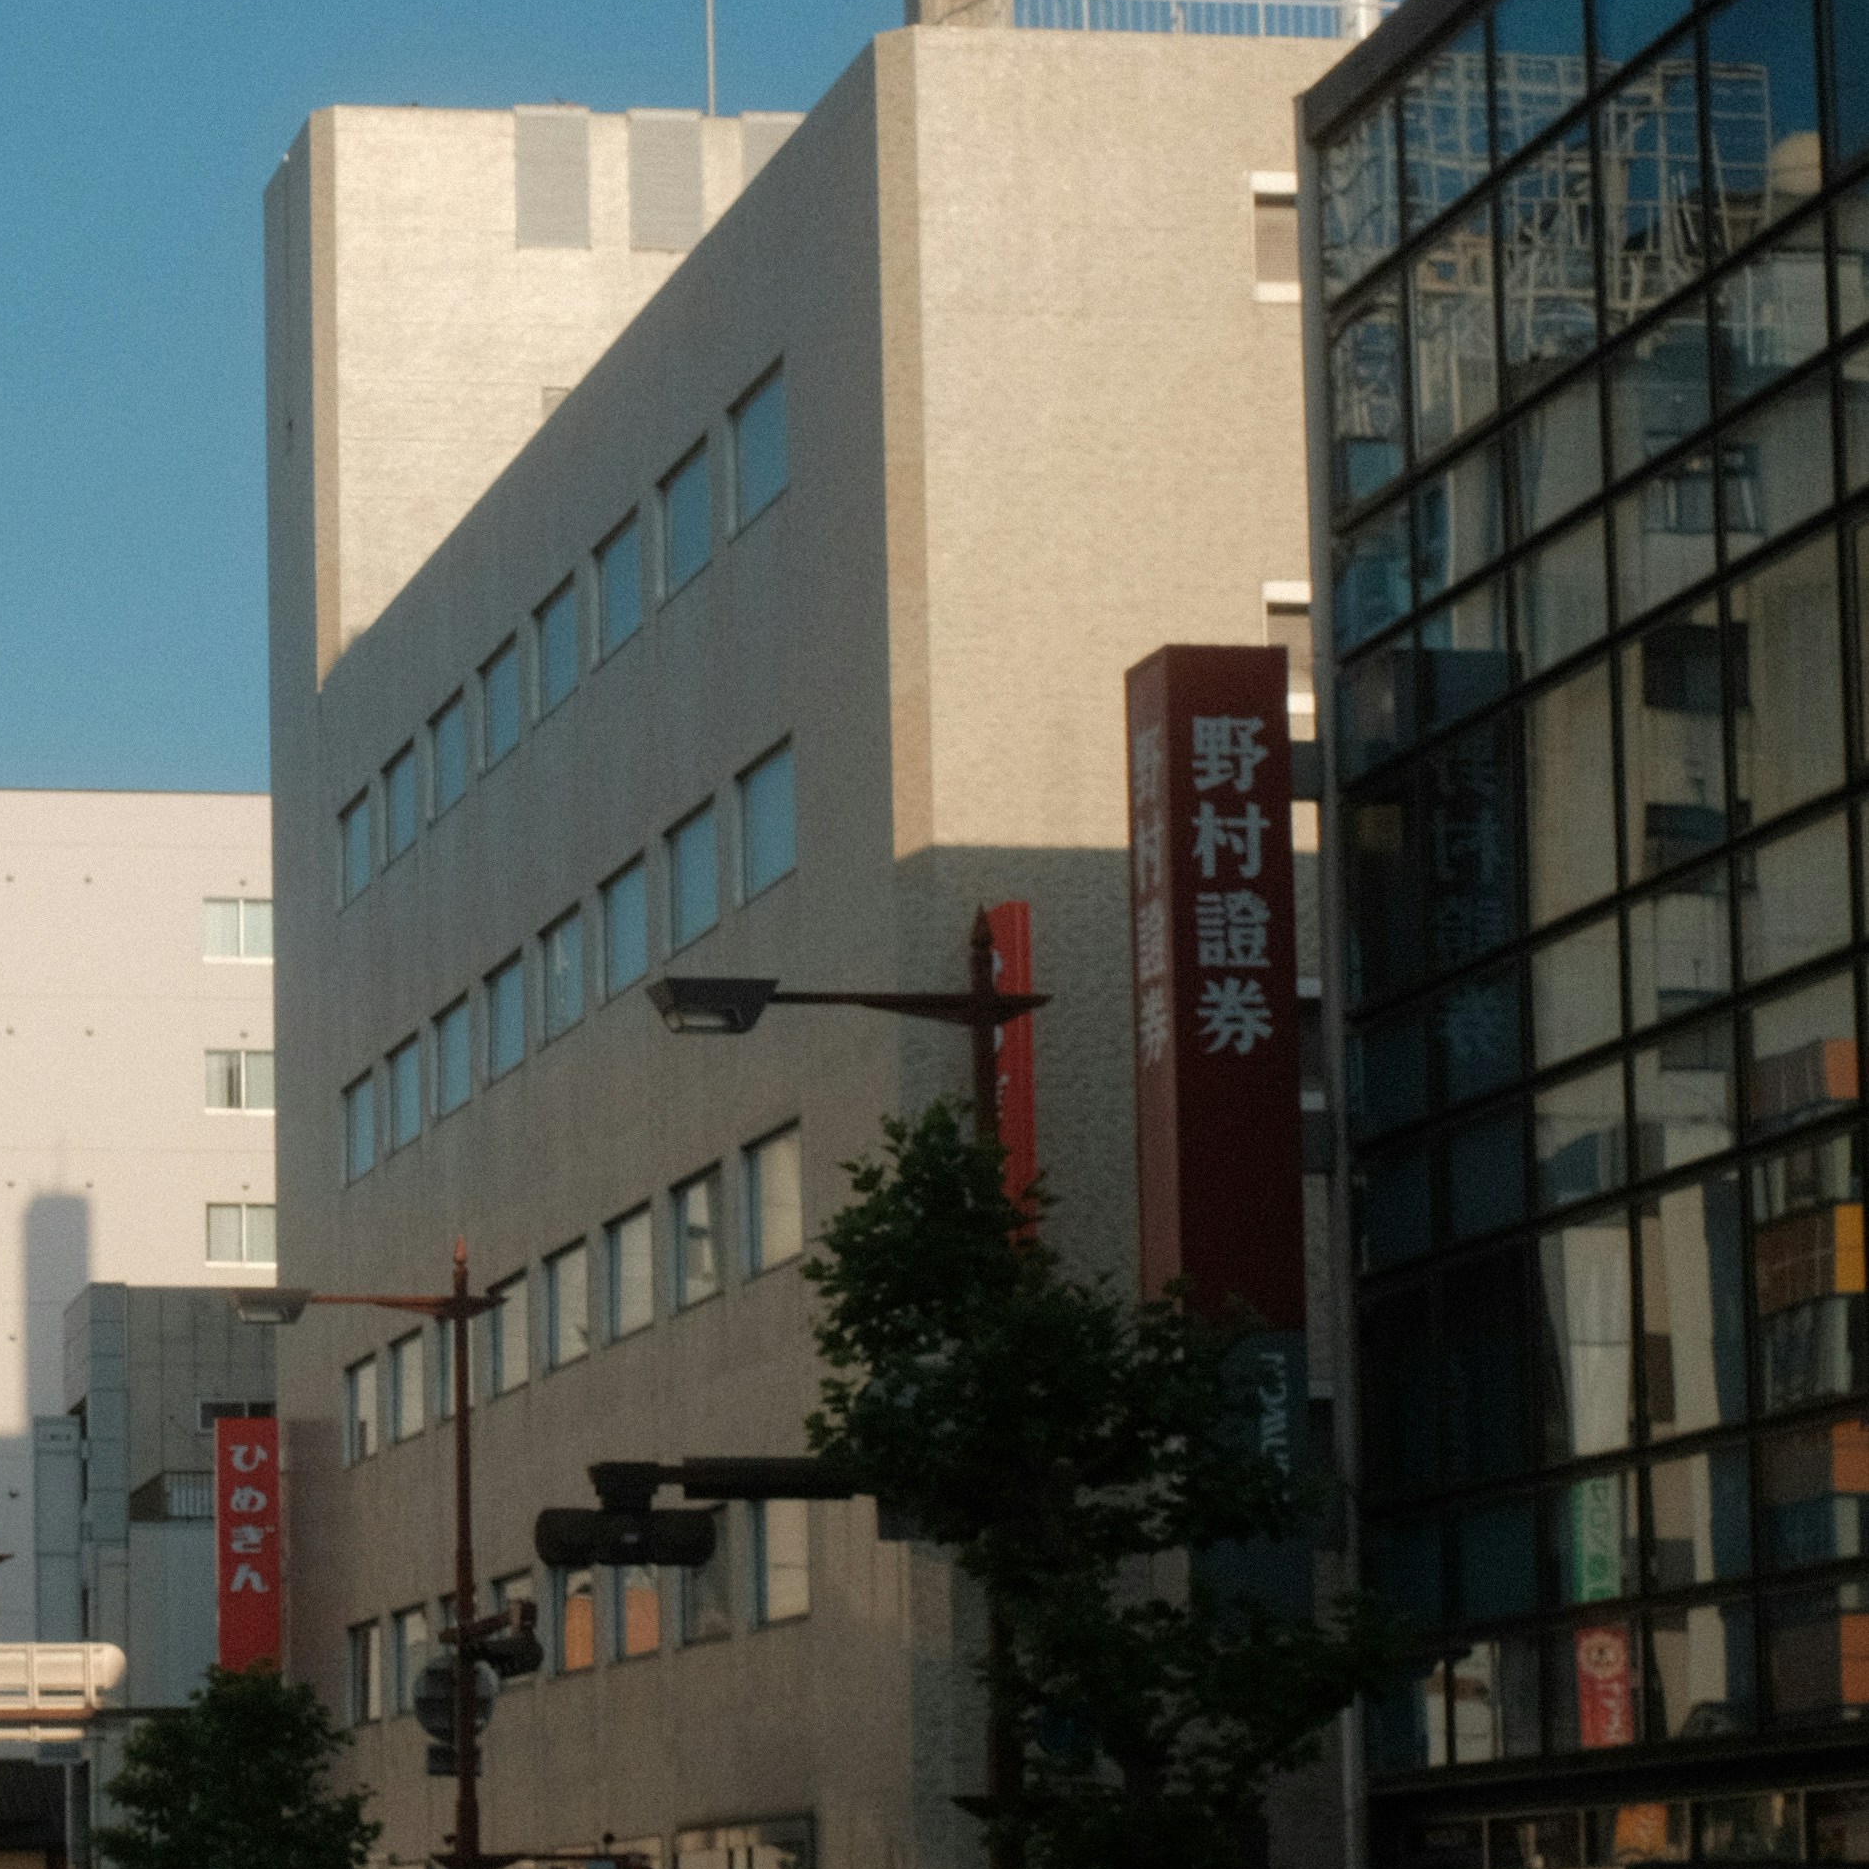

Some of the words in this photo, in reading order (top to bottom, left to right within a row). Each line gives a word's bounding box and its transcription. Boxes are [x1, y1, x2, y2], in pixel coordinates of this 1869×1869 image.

[1191, 714, 1275, 1057] 野村證券
[229, 1443, 275, 1595] ひめぎん
